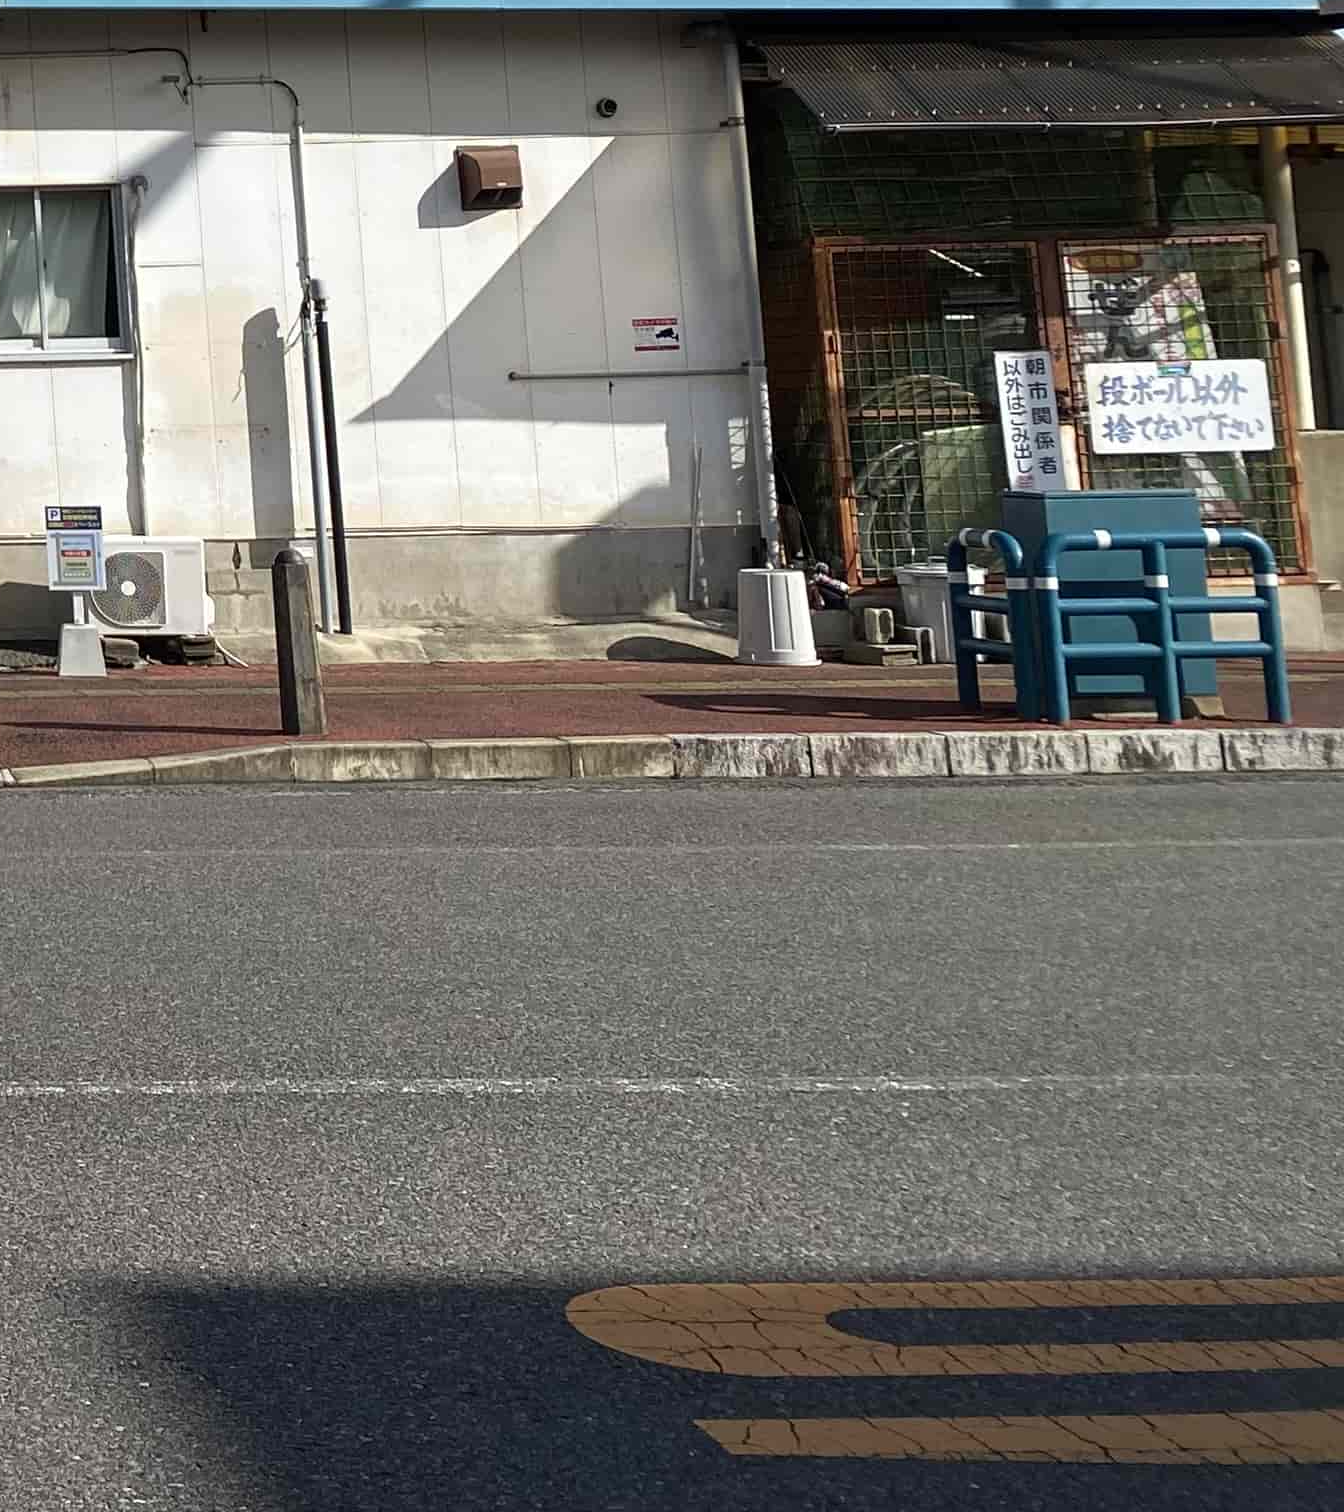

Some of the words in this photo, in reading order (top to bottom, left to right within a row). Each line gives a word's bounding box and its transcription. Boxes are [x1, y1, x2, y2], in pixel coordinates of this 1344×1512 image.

[1025, 358, 1057, 474] 朝市関係者
[1096, 371, 1248, 406] 段ボール以外
